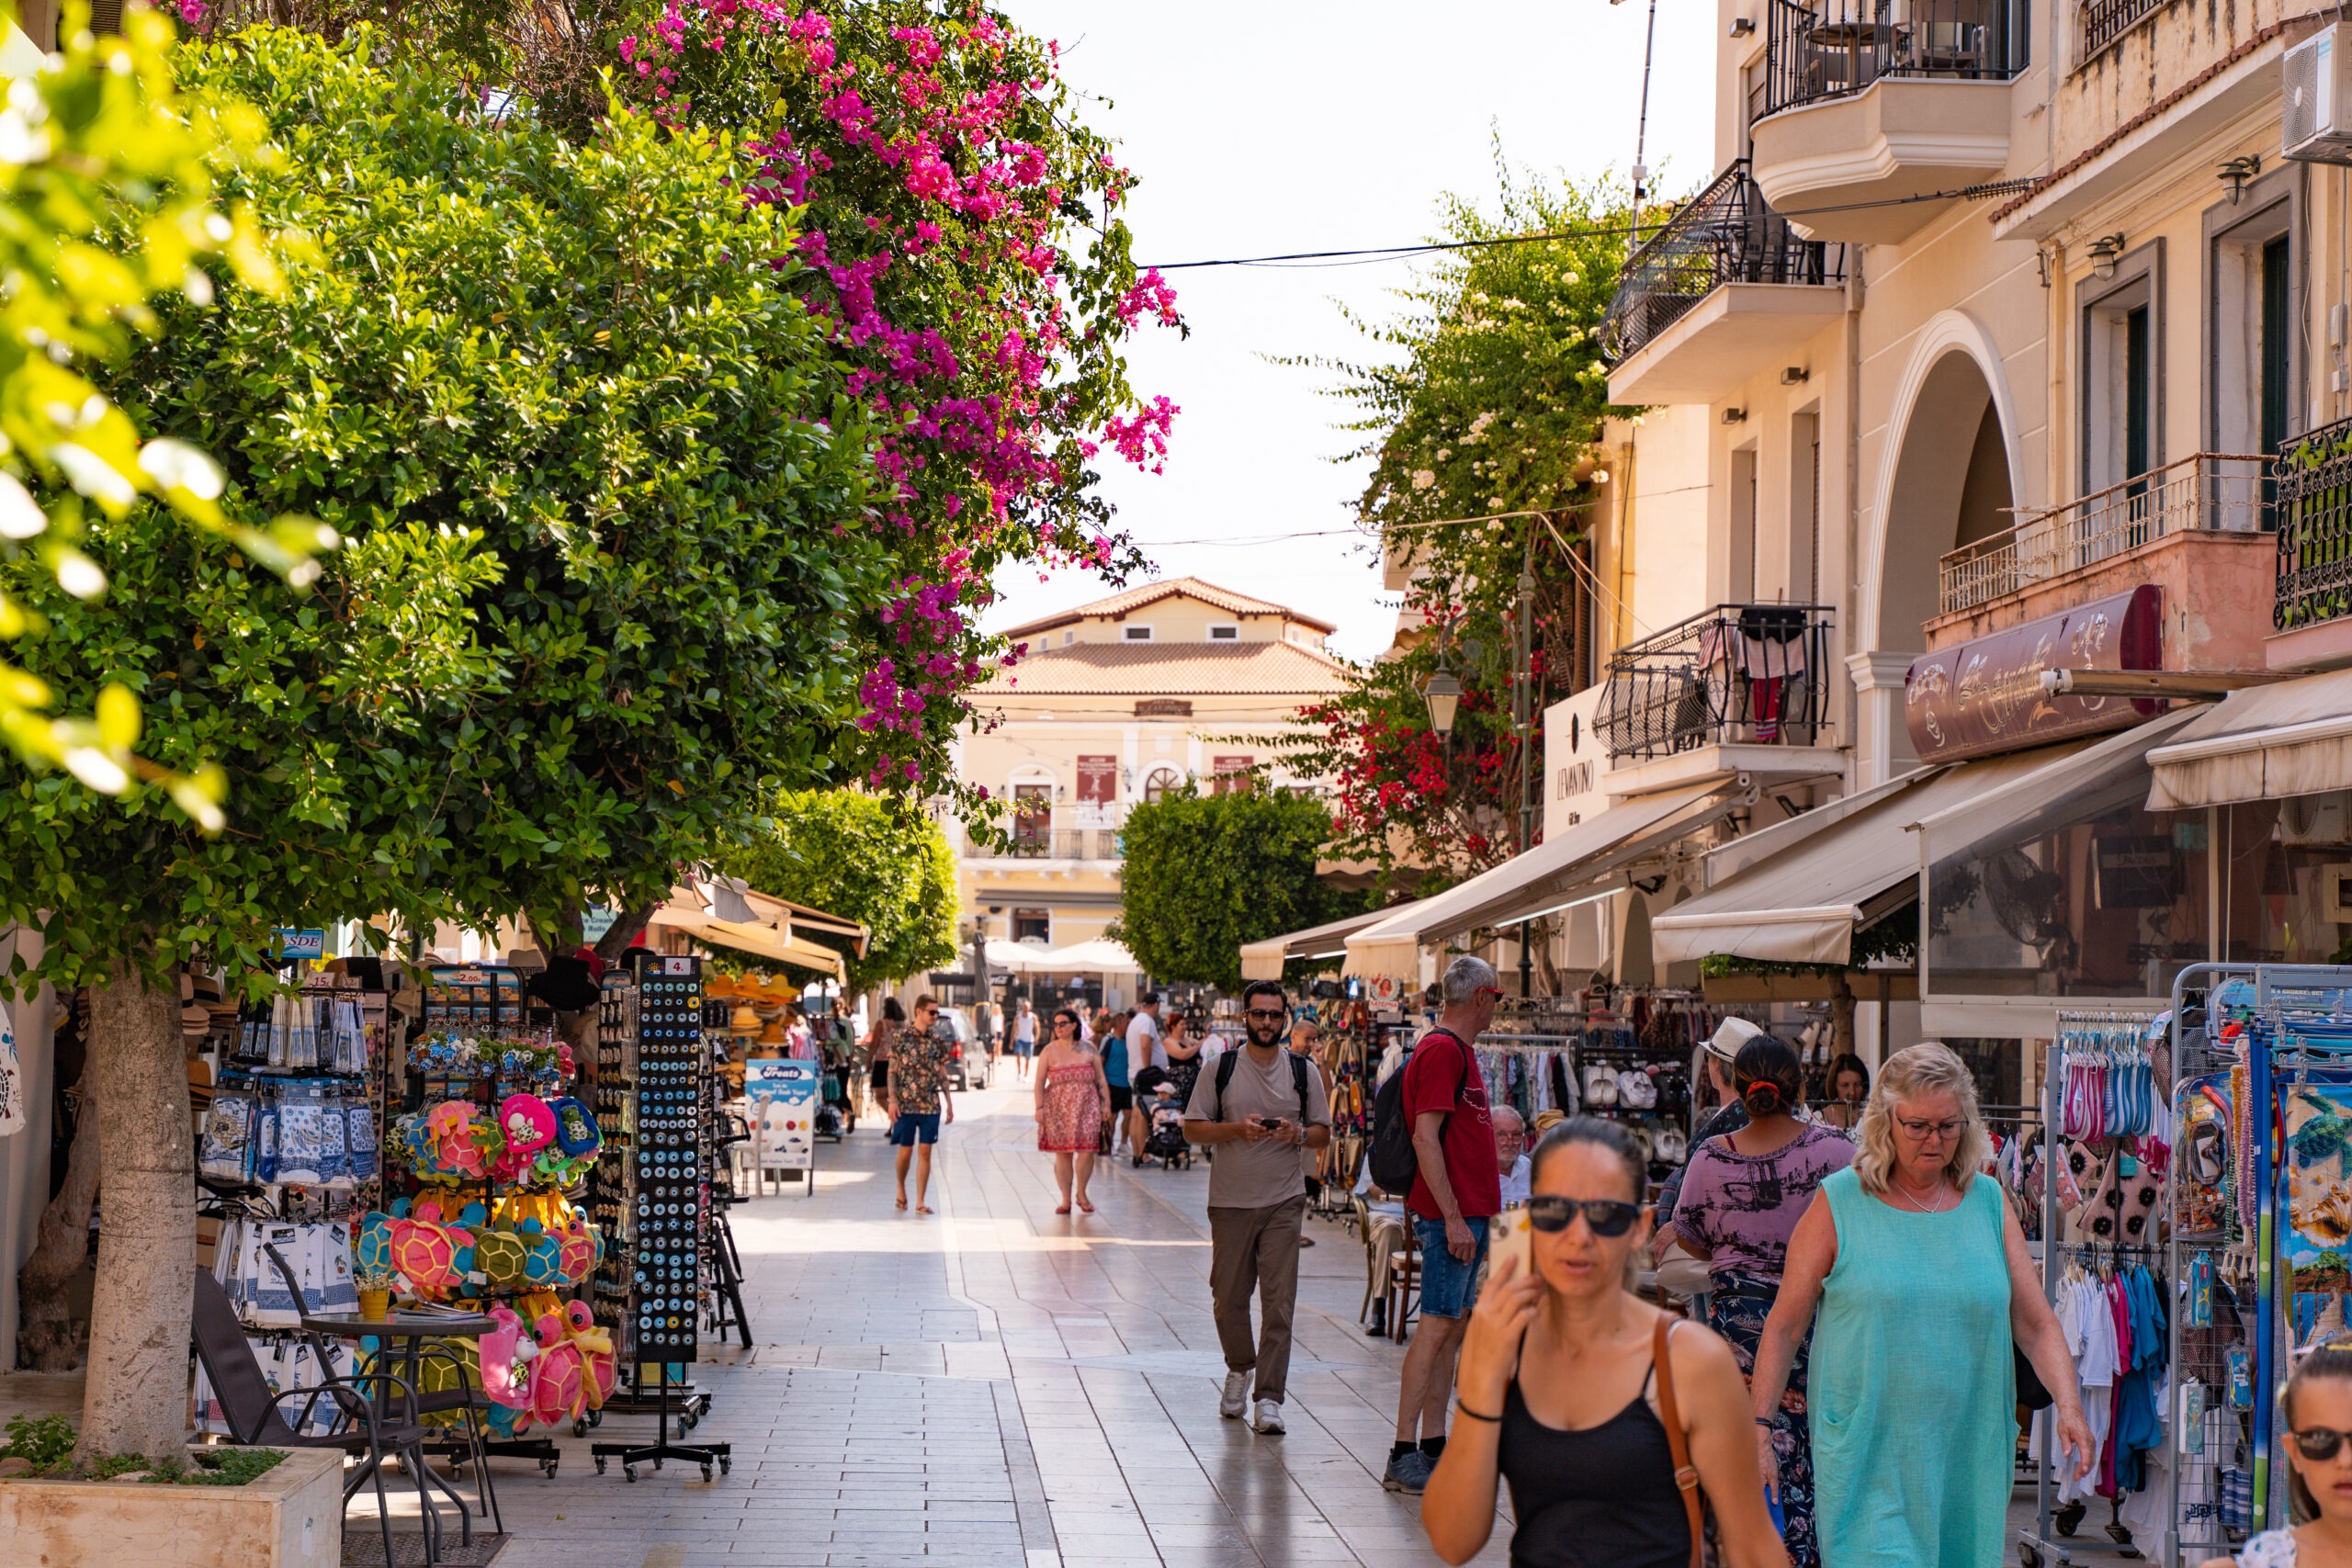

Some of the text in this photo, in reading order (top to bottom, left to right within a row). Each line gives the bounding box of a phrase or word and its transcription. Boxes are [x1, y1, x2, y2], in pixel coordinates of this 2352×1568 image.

[1557, 759, 1594, 801] LEVANTINO
[285, 936, 320, 947] SDE
[763, 1066, 799, 1077] Treats
